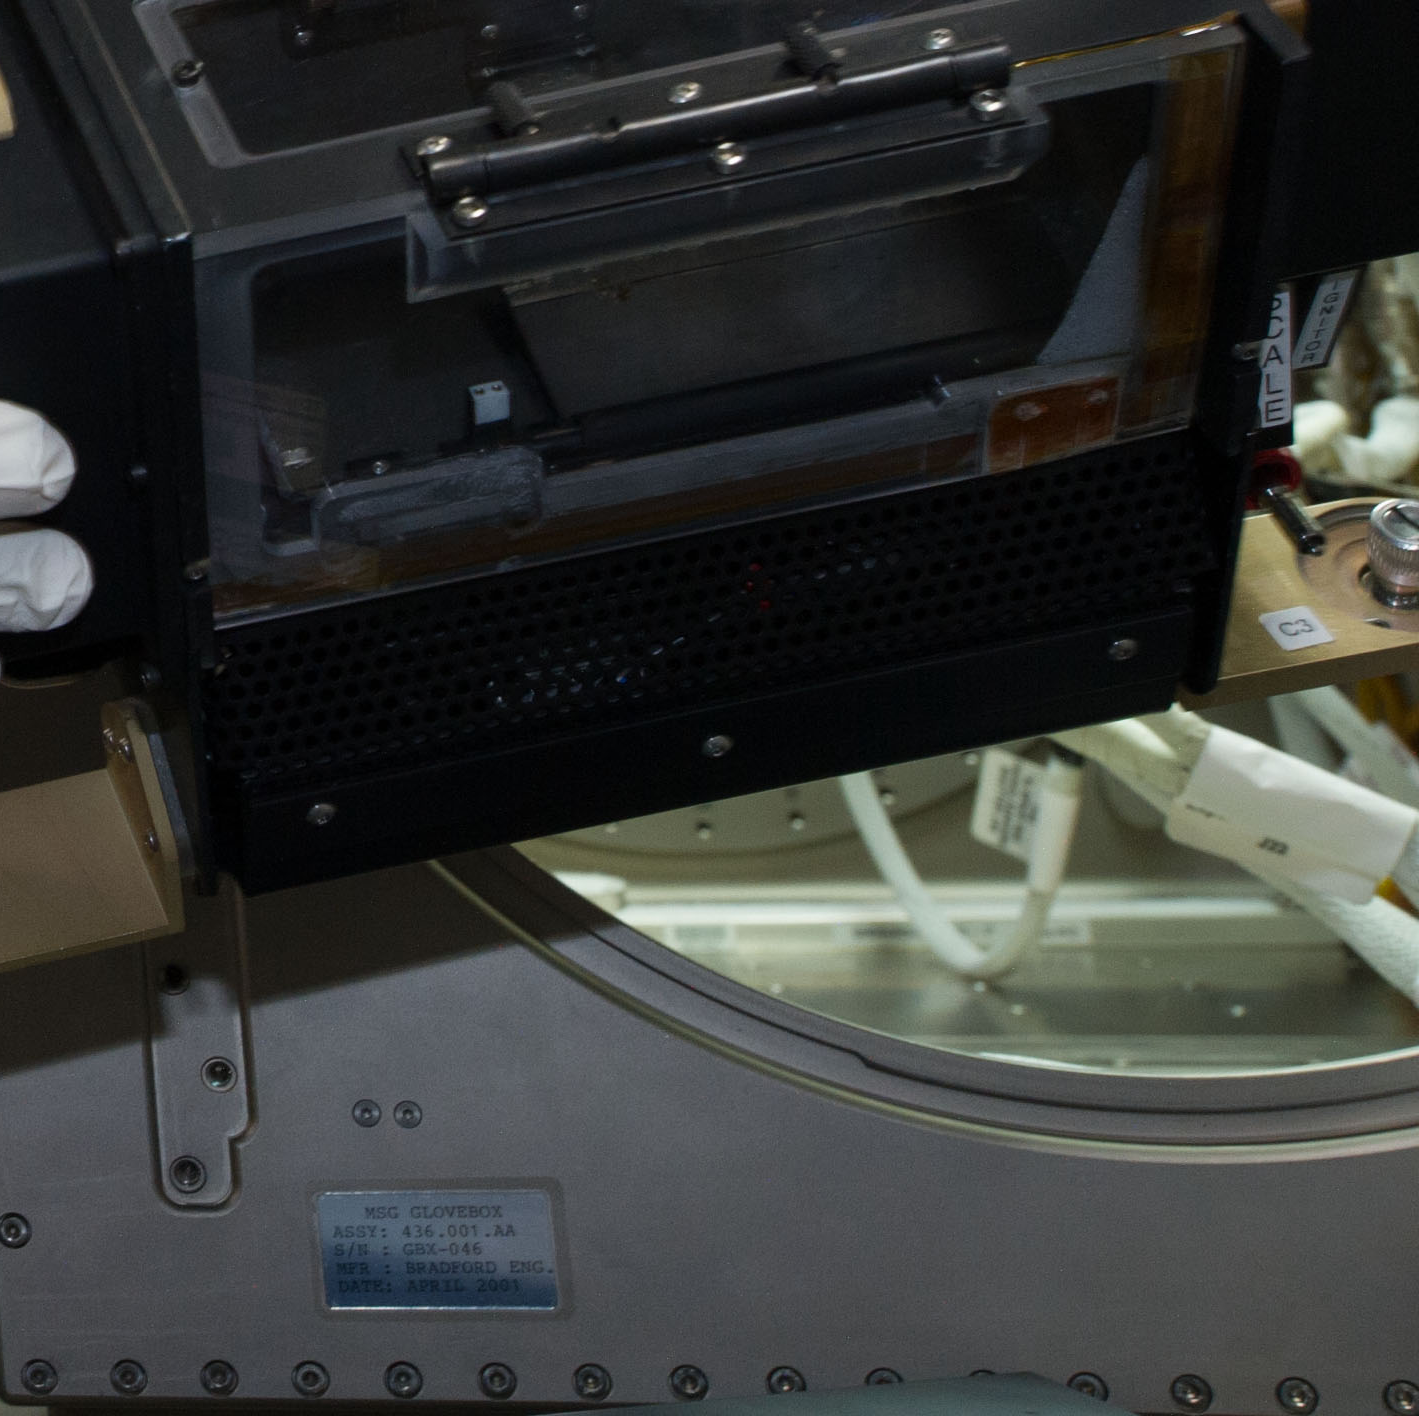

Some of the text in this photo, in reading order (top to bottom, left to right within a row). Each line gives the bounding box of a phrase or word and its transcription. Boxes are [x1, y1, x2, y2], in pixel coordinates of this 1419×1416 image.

[1301, 280, 1339, 364] IGNITOR
[1278, 618, 1314, 636] C3
[365, 1205, 503, 1219] MSG GLOVEBOX
[333, 1224, 516, 1238] ASSY: 436.001.AA
[334, 1243, 369, 1257] S/N
[403, 1242, 483, 1256] GBX-046
[337, 1262, 370, 1275] MFR
[406, 1261, 497, 1274] BRADFORD
[510, 1261, 554, 1274] ENG.
[338, 1280, 392, 1294] DATE:
[407, 1280, 464, 1293] APRIL
